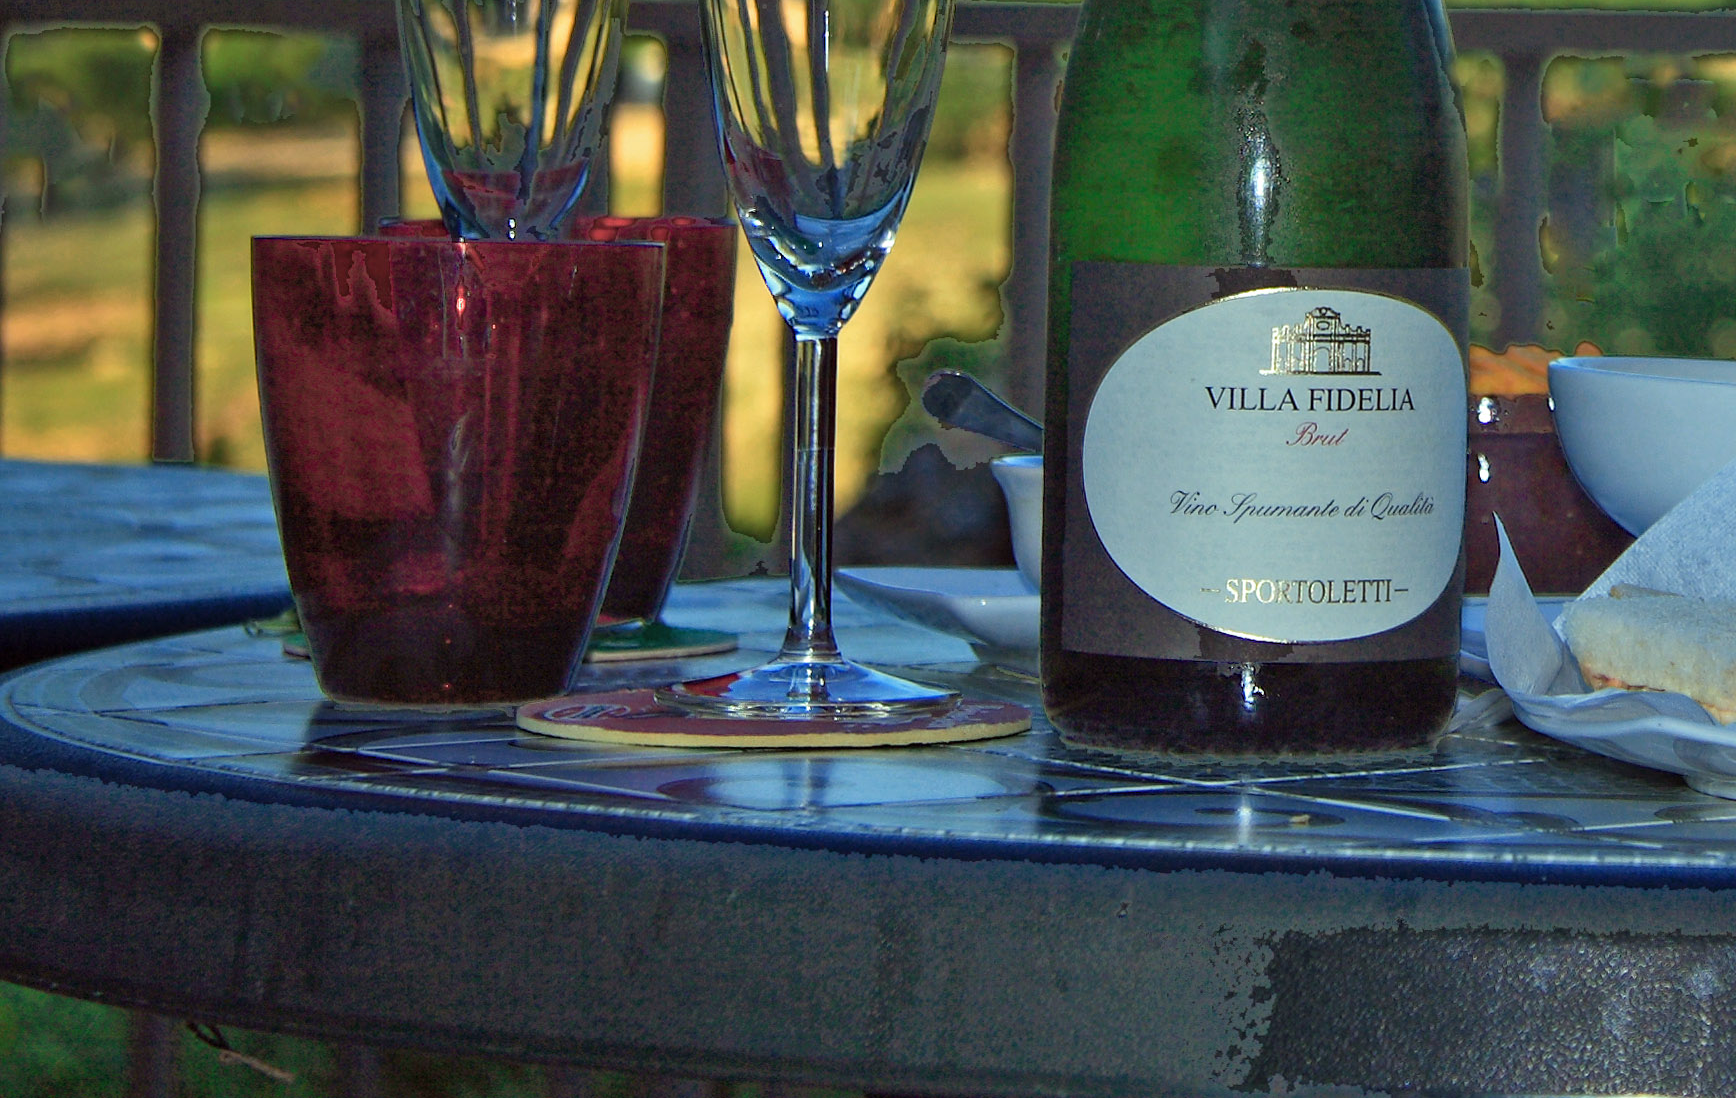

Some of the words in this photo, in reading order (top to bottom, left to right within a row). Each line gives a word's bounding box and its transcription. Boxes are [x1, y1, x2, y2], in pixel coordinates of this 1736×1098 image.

[1205, 387, 1299, 412] VILLA
[1308, 388, 1416, 412] FIDELIA
[1286, 422, 1349, 447] Brut
[1169, 490, 1219, 517] Vino
[1223, 492, 1340, 524] Spumante
[1344, 494, 1369, 518] di
[1371, 492, 1435, 521] Qualità
[1225, 579, 1392, 604] SPORTOLETTI
